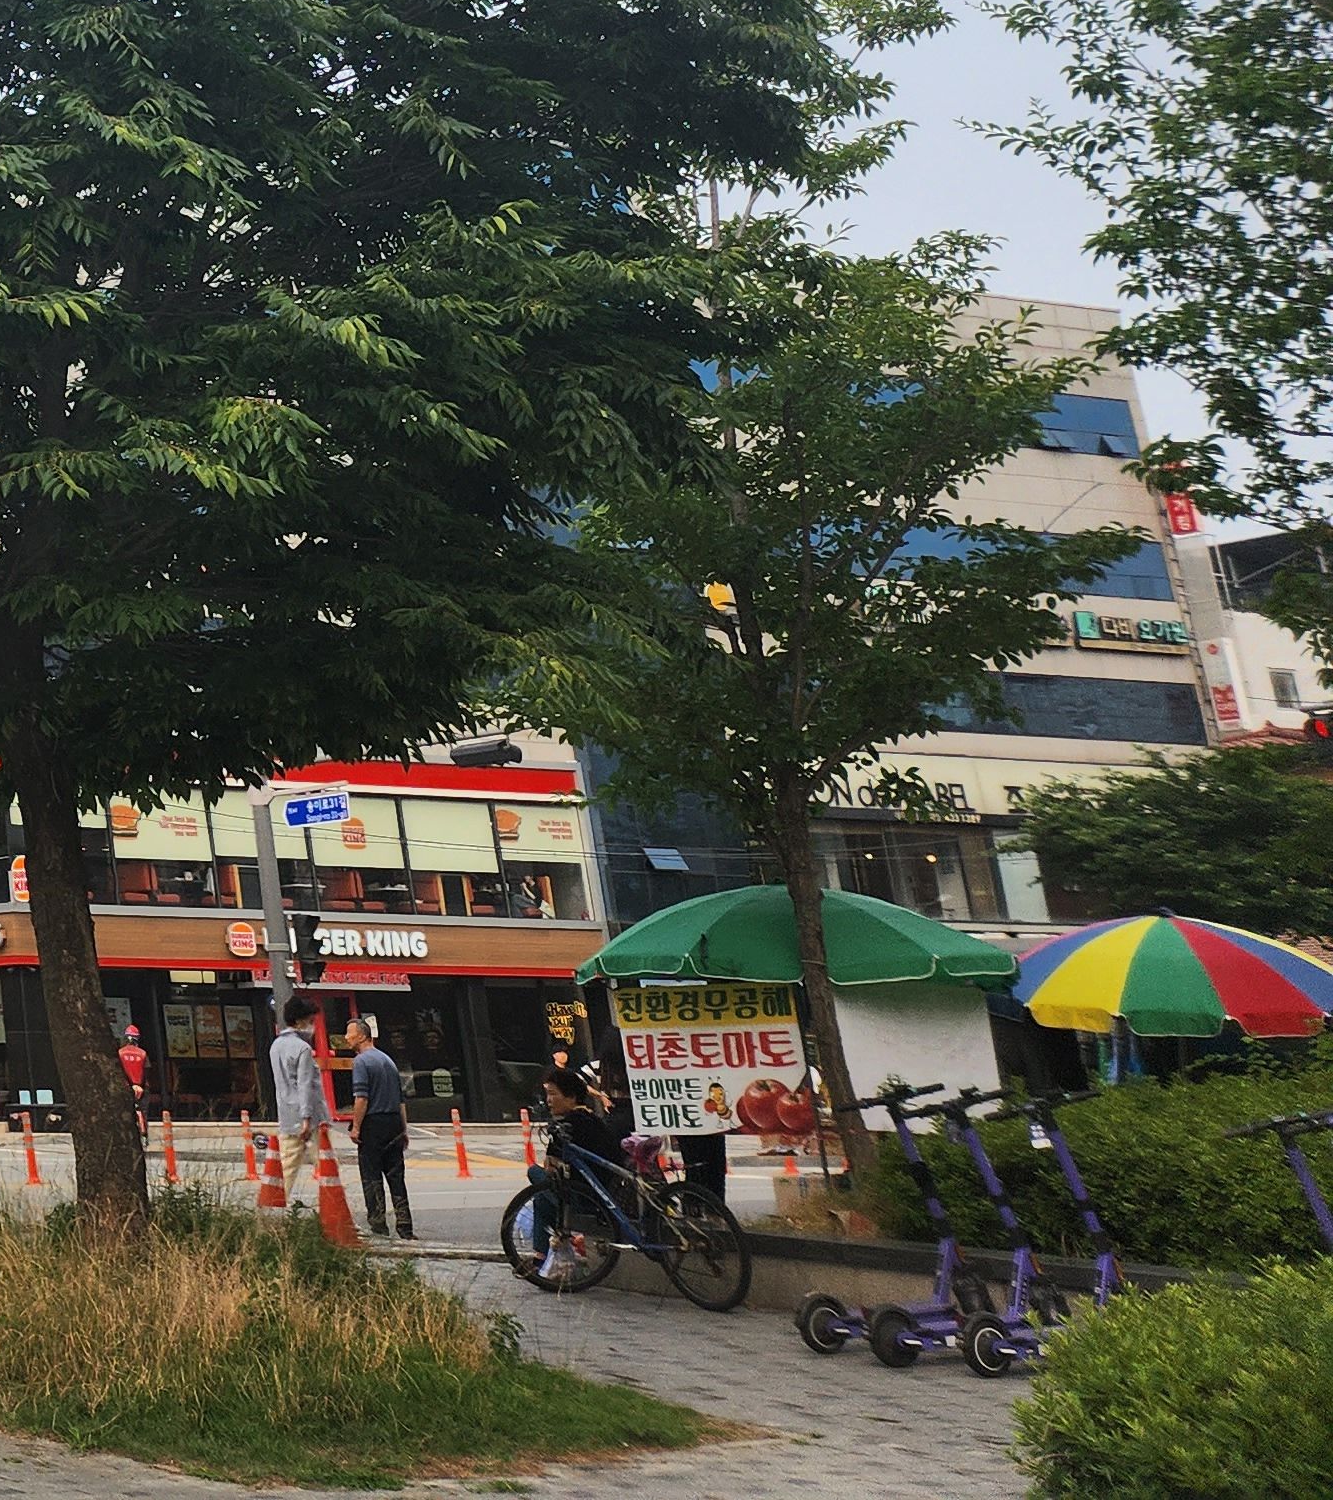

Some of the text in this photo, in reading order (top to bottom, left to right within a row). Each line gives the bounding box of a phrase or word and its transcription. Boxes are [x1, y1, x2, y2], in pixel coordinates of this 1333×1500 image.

[231, 939, 255, 949] KING
[364, 929, 429, 958] KING
[617, 986, 792, 1022] 친환경무공해
[626, 1030, 798, 1071] 퇴촌토마토
[640, 1104, 704, 1129] 토마토
